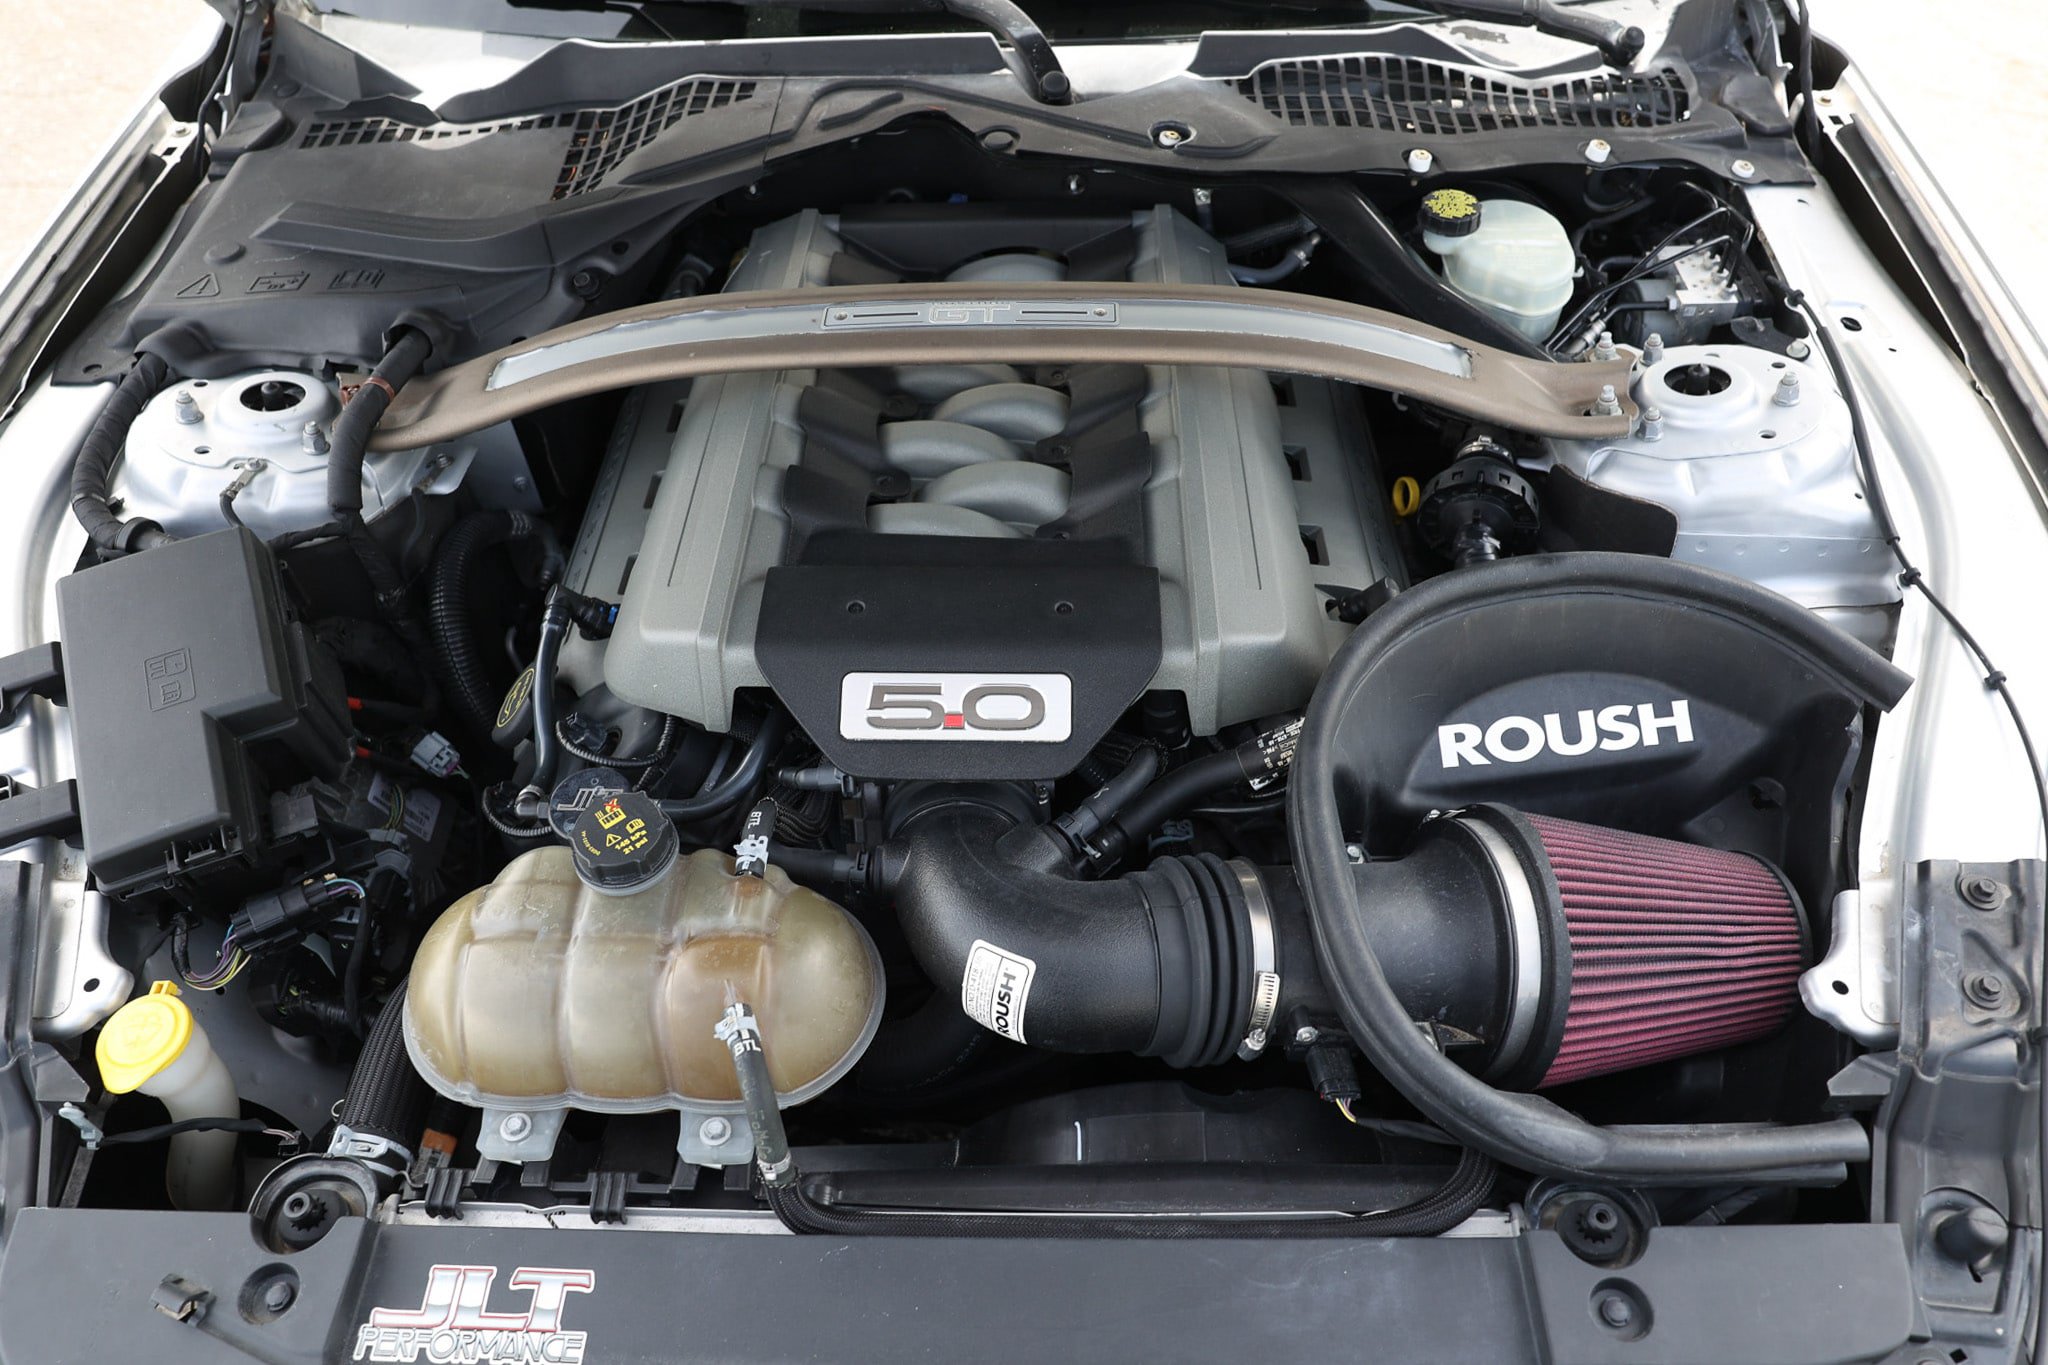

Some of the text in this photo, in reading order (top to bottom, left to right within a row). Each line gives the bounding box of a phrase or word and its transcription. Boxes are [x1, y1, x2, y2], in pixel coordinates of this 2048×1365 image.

[928, 303, 1010, 323] GT
[866, 683, 1046, 731] 5.0
[1438, 699, 1694, 769] ROUSH
[635, 837, 649, 849] psi
[995, 972, 1017, 1036] ROUSH
[734, 1039, 762, 1057] BTL
[371, 1266, 594, 1332] JLT
[355, 1326, 586, 1364] PERFORMANCE
